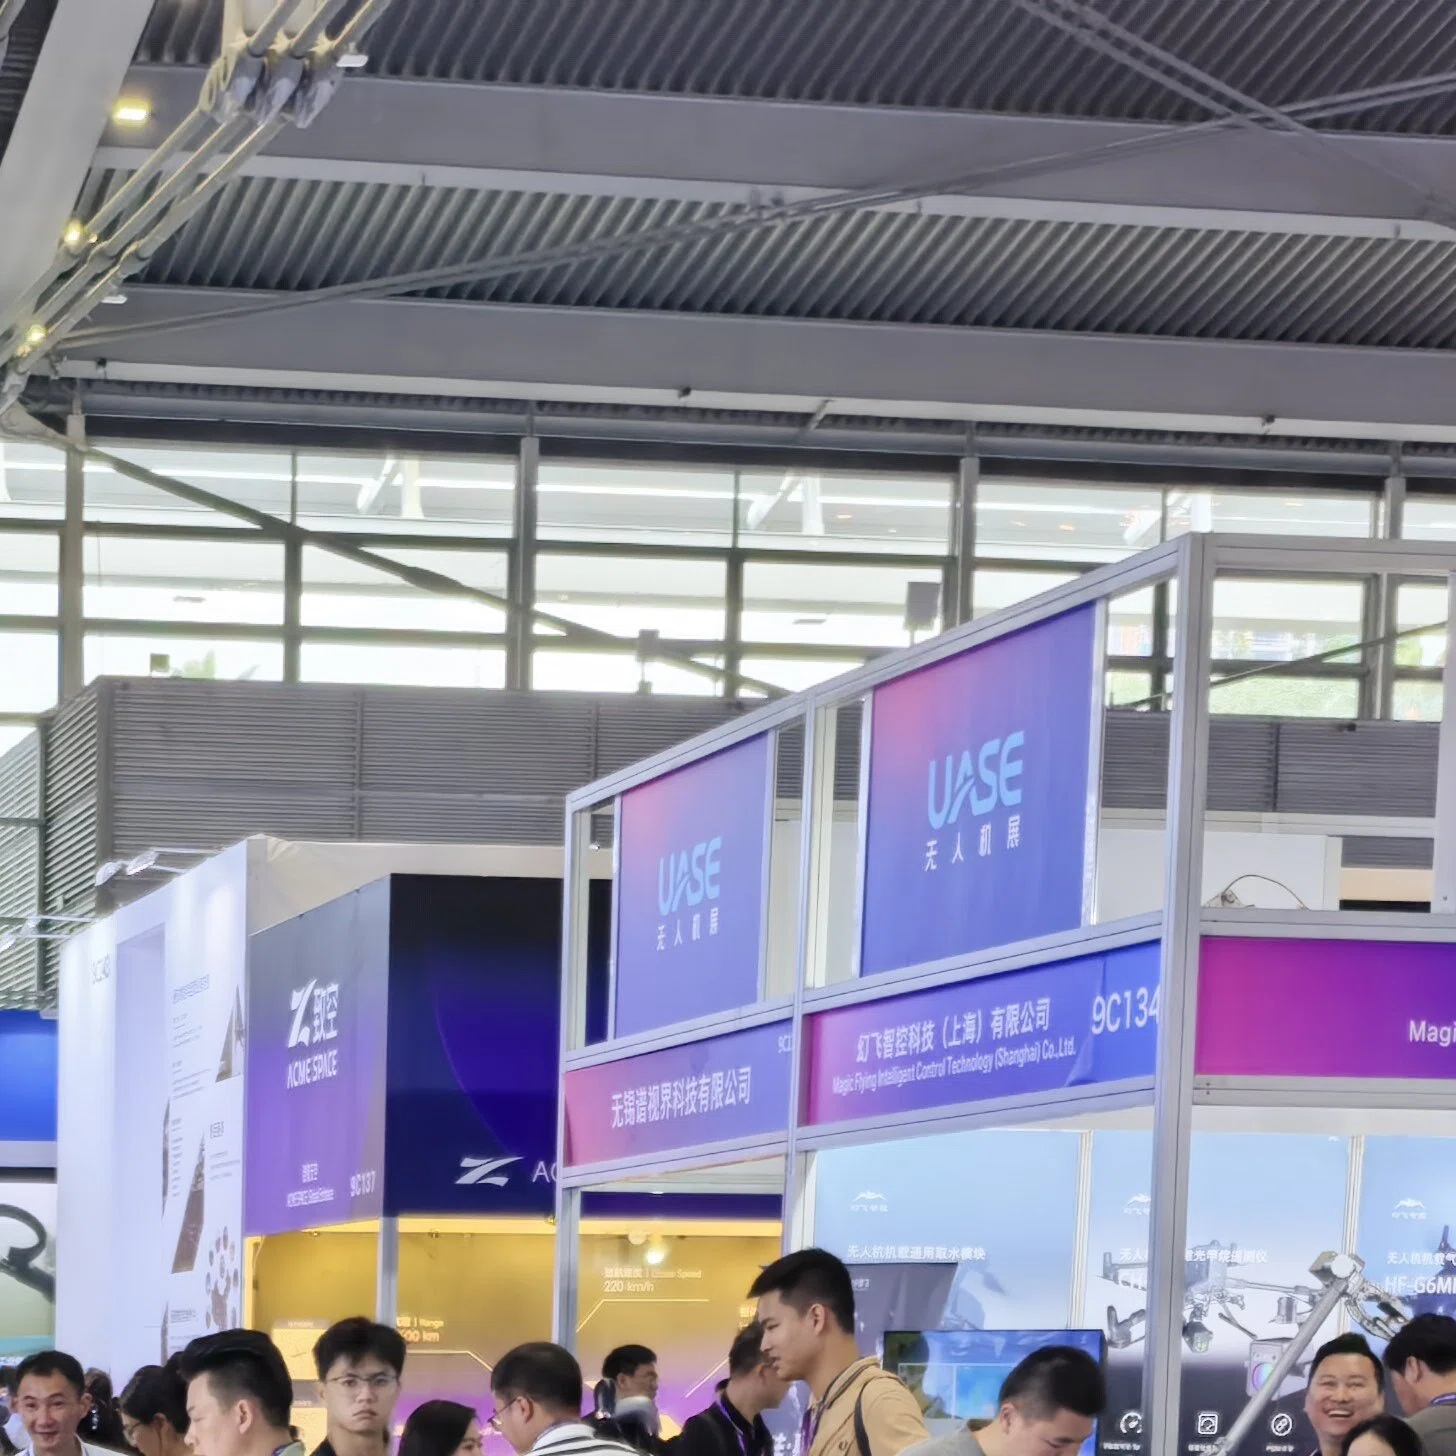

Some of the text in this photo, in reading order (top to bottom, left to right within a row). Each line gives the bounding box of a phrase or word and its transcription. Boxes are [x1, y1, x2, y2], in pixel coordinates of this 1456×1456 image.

[927, 730, 1025, 830] UASE
[924, 815, 1022, 873] 无人机展
[658, 835, 722, 917] UASE
[657, 907, 719, 952] 无人机展
[1091, 986, 1160, 1035] 9C134
[916, 1057, 946, 1081] Control
[946, 1051, 993, 1077] Technology
[604, 1280, 624, 1293] 220
